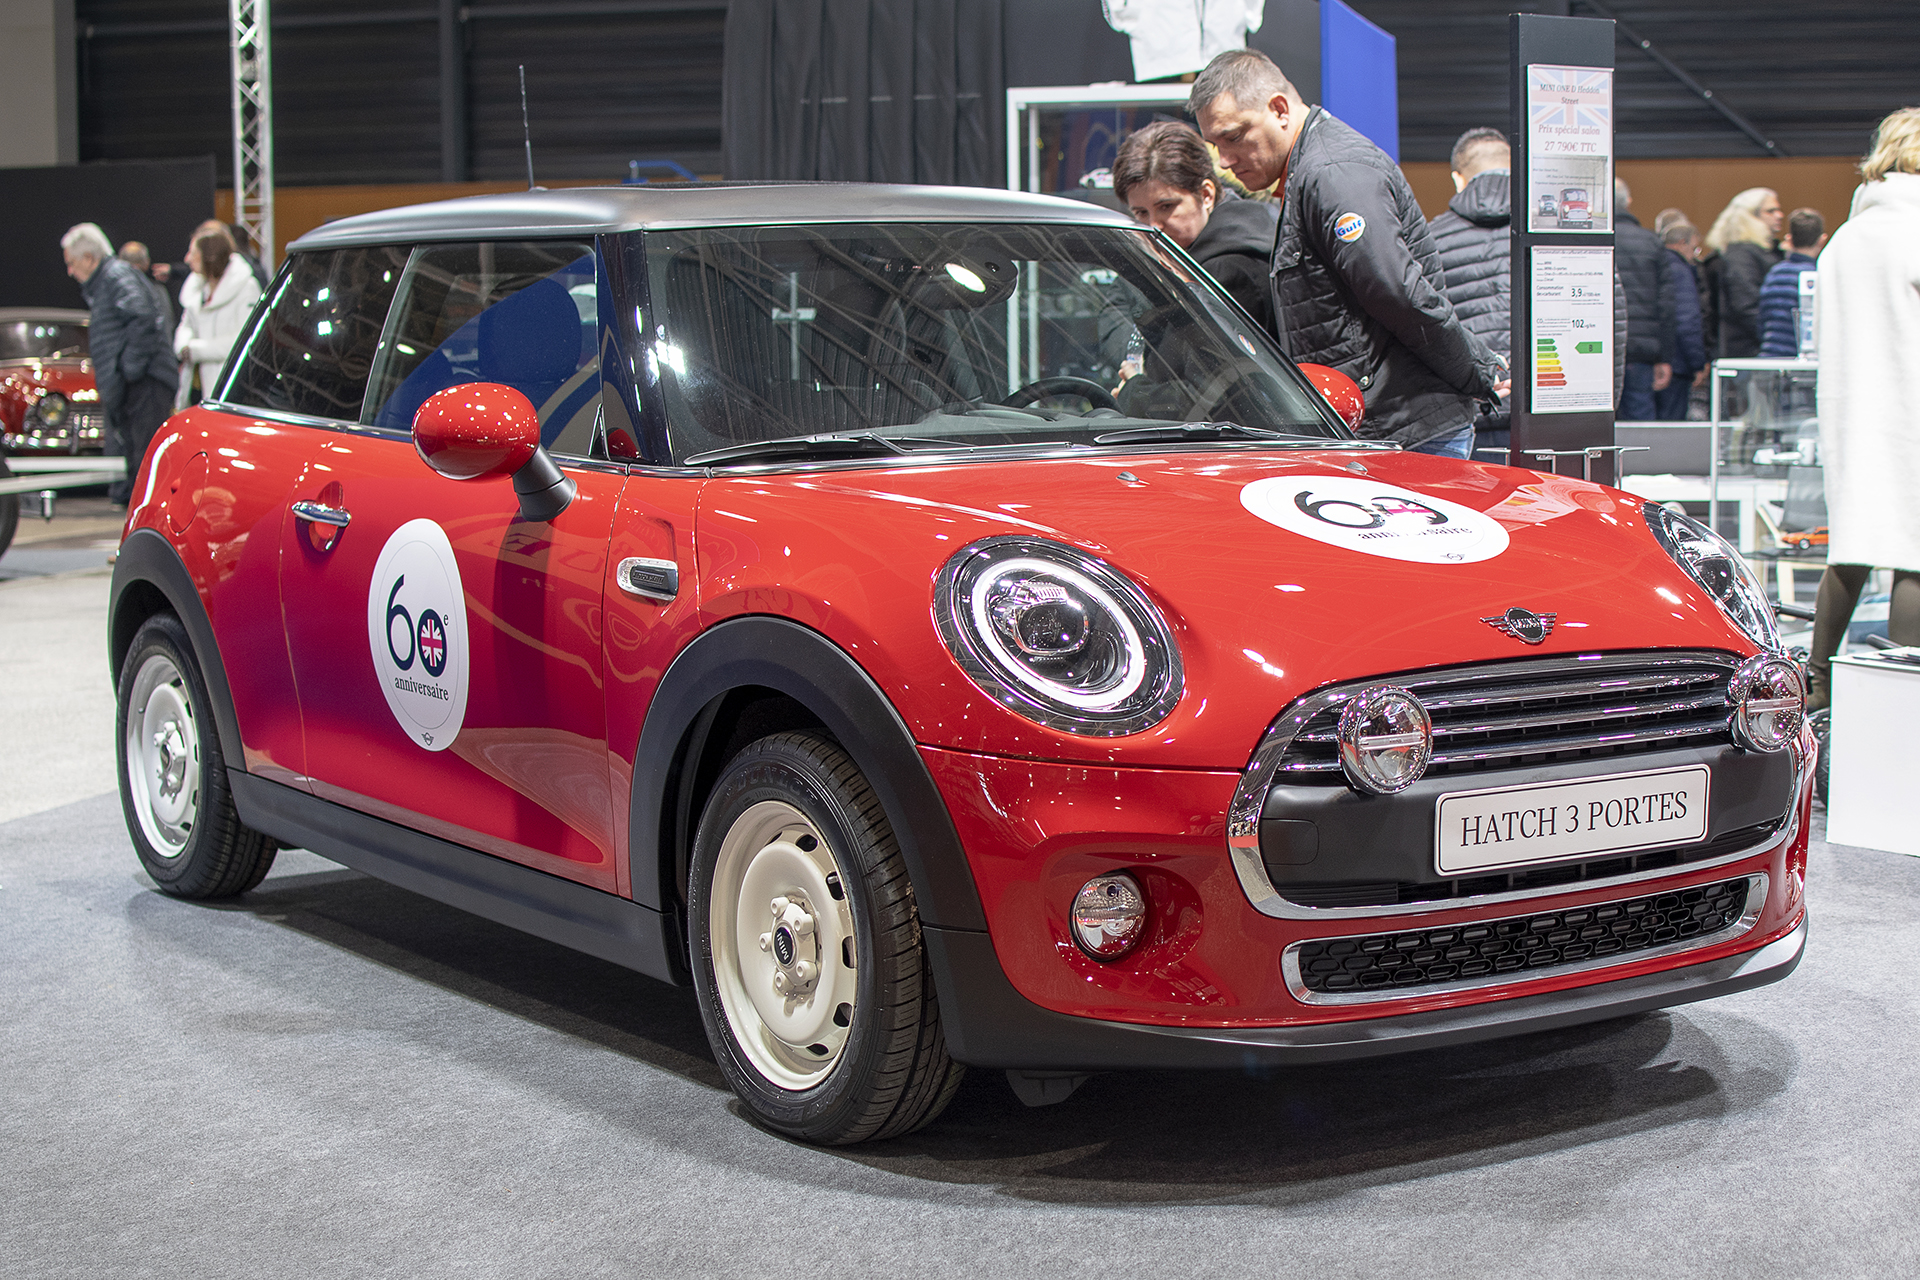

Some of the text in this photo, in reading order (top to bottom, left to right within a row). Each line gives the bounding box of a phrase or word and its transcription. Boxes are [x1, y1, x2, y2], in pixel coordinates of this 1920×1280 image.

[1539, 83, 1555, 92] MINI
[1556, 84, 1571, 93] ONE
[1571, 84, 1577, 93] D
[1561, 96, 1579, 105] Street
[1538, 124, 1600, 136] Prix spécial salon
[1544, 140, 1597, 153] 27 790€ TTC
[1337, 219, 1362, 236] Gulf
[1571, 287, 1583, 298] 3,9
[1572, 319, 1585, 328] 102
[395, 675, 449, 701] anniversaire
[1460, 790, 1688, 847] HATCH 3 PORTES
[776, 931, 790, 960] MINI
